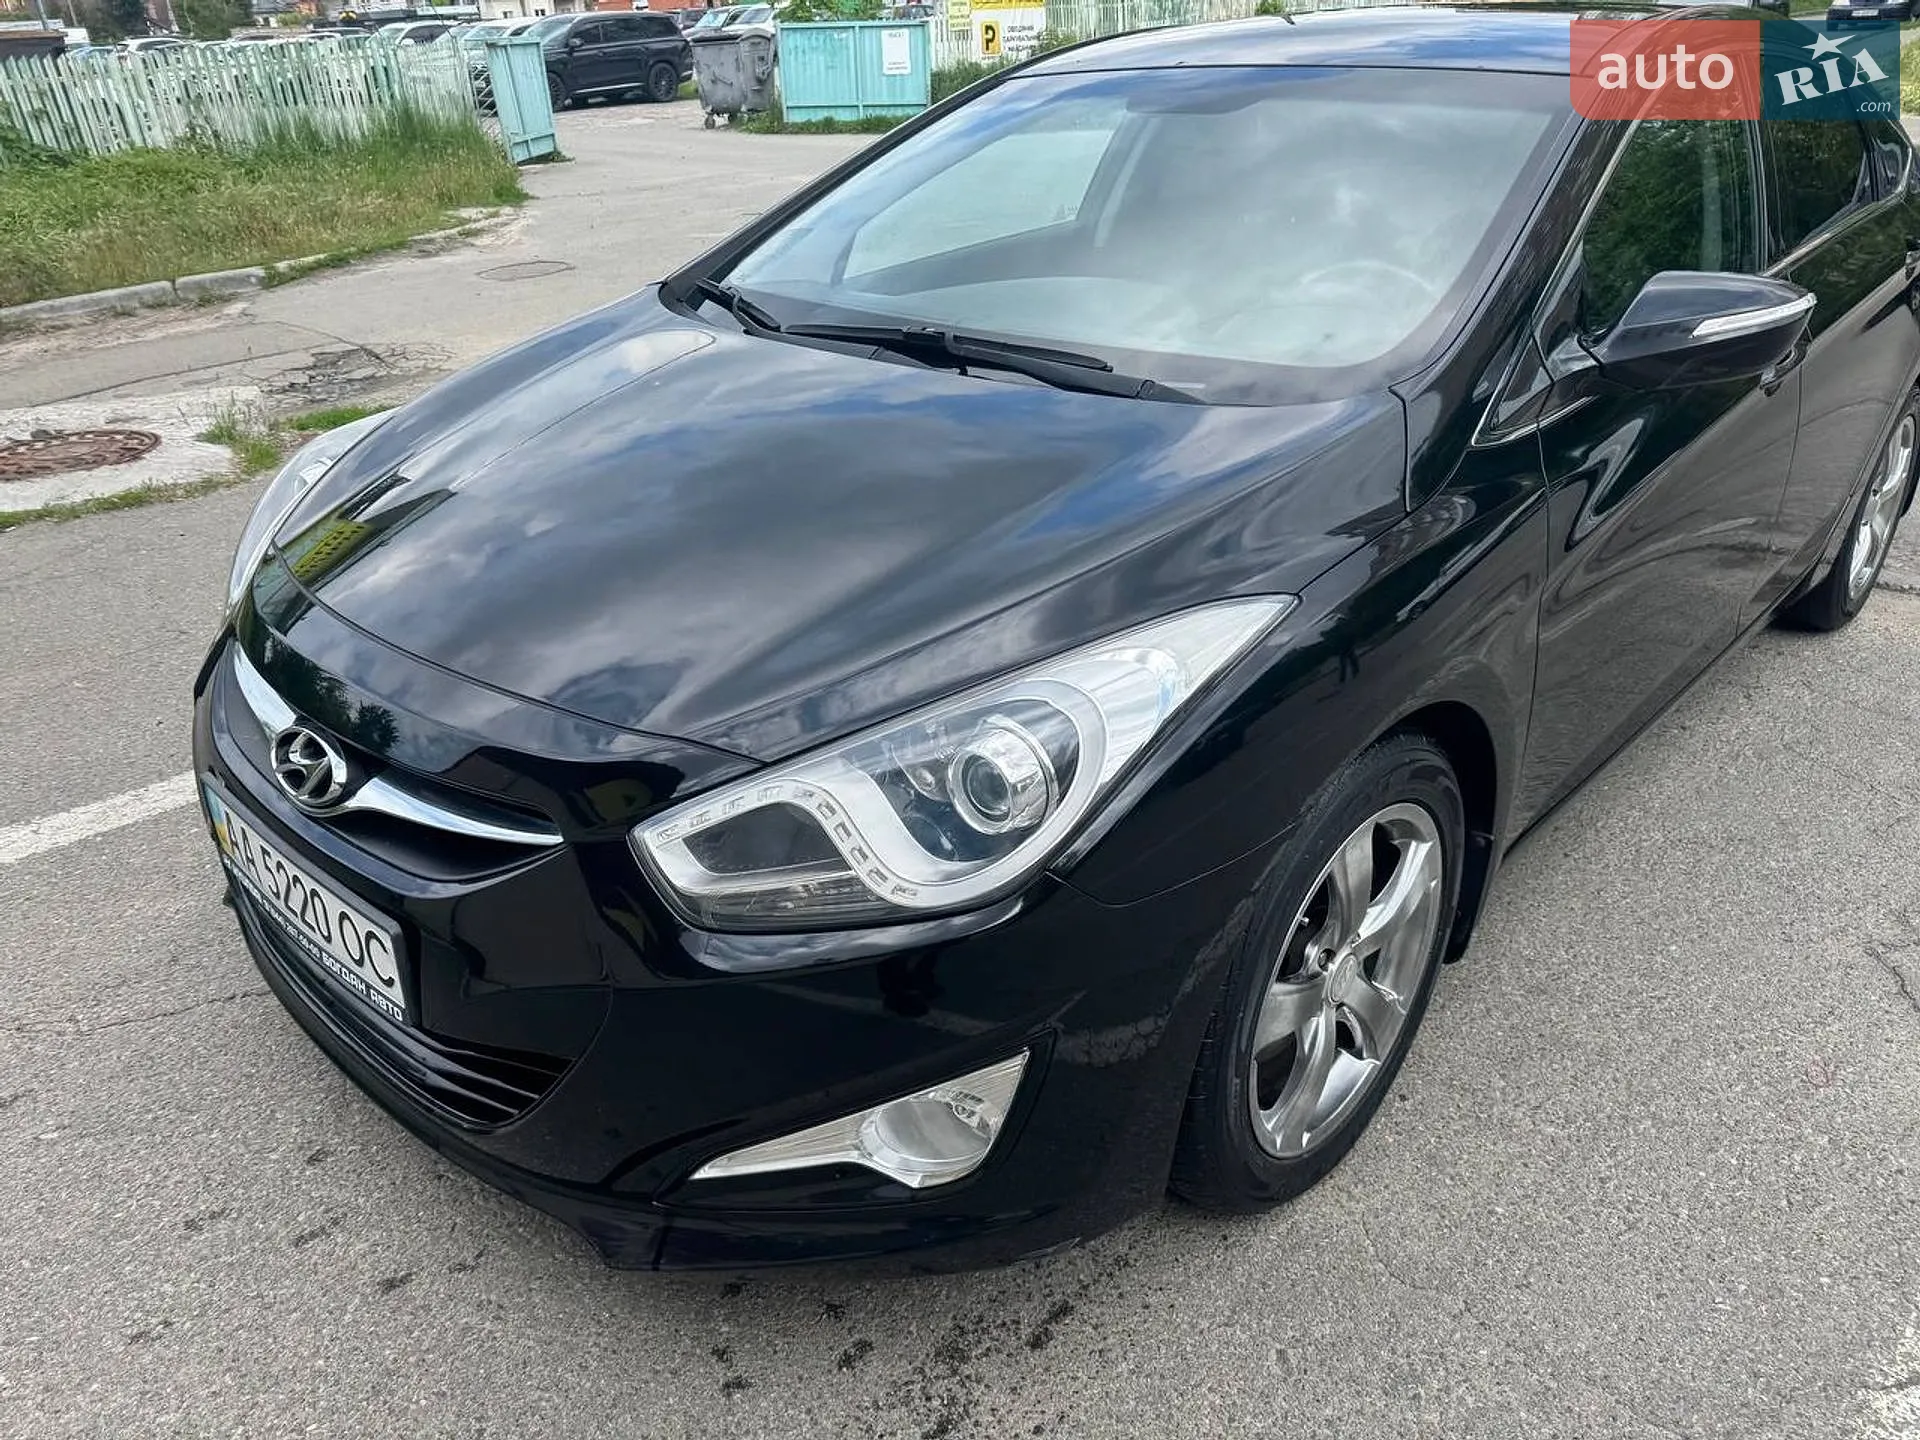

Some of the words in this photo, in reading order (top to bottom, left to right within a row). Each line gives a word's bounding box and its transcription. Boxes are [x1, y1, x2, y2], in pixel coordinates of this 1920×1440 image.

[984, 24, 996, 51] P
[225, 810, 262, 887] AA
[260, 845, 332, 944] 5220
[339, 910, 394, 987] OC
[322, 951, 367, 995] БОГДАН
